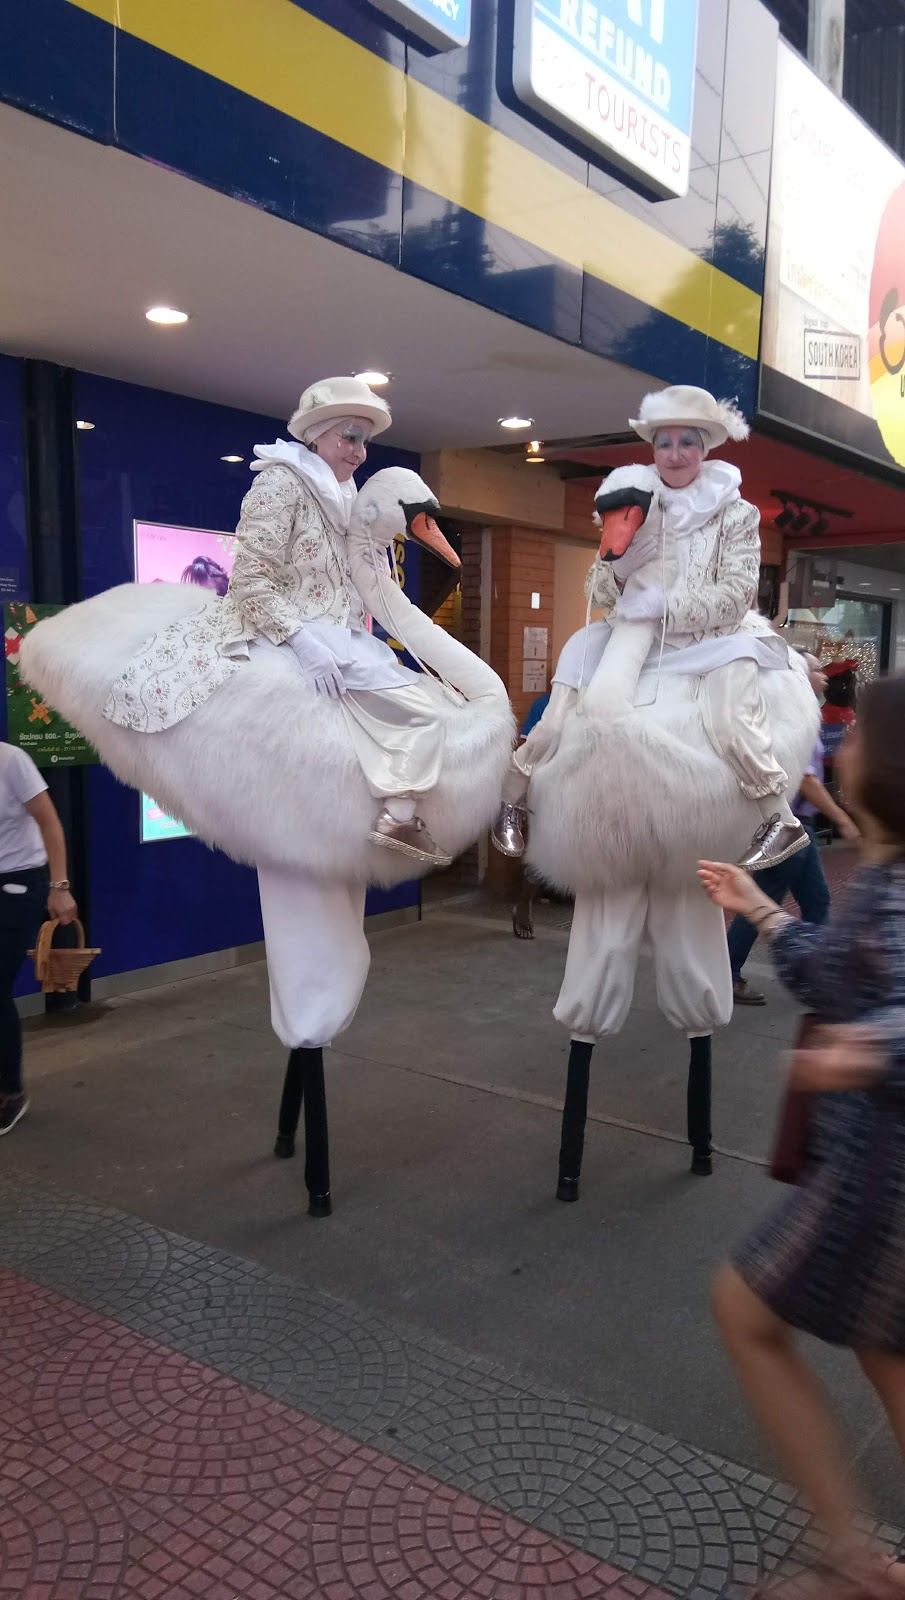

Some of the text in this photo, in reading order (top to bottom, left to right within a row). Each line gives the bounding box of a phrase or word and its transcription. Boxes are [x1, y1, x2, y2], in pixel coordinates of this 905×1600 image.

[559, 0, 671, 108] REFUND
[583, 72, 681, 174] TOURISTS
[808, 341, 858, 369] SOUTH KOREA
